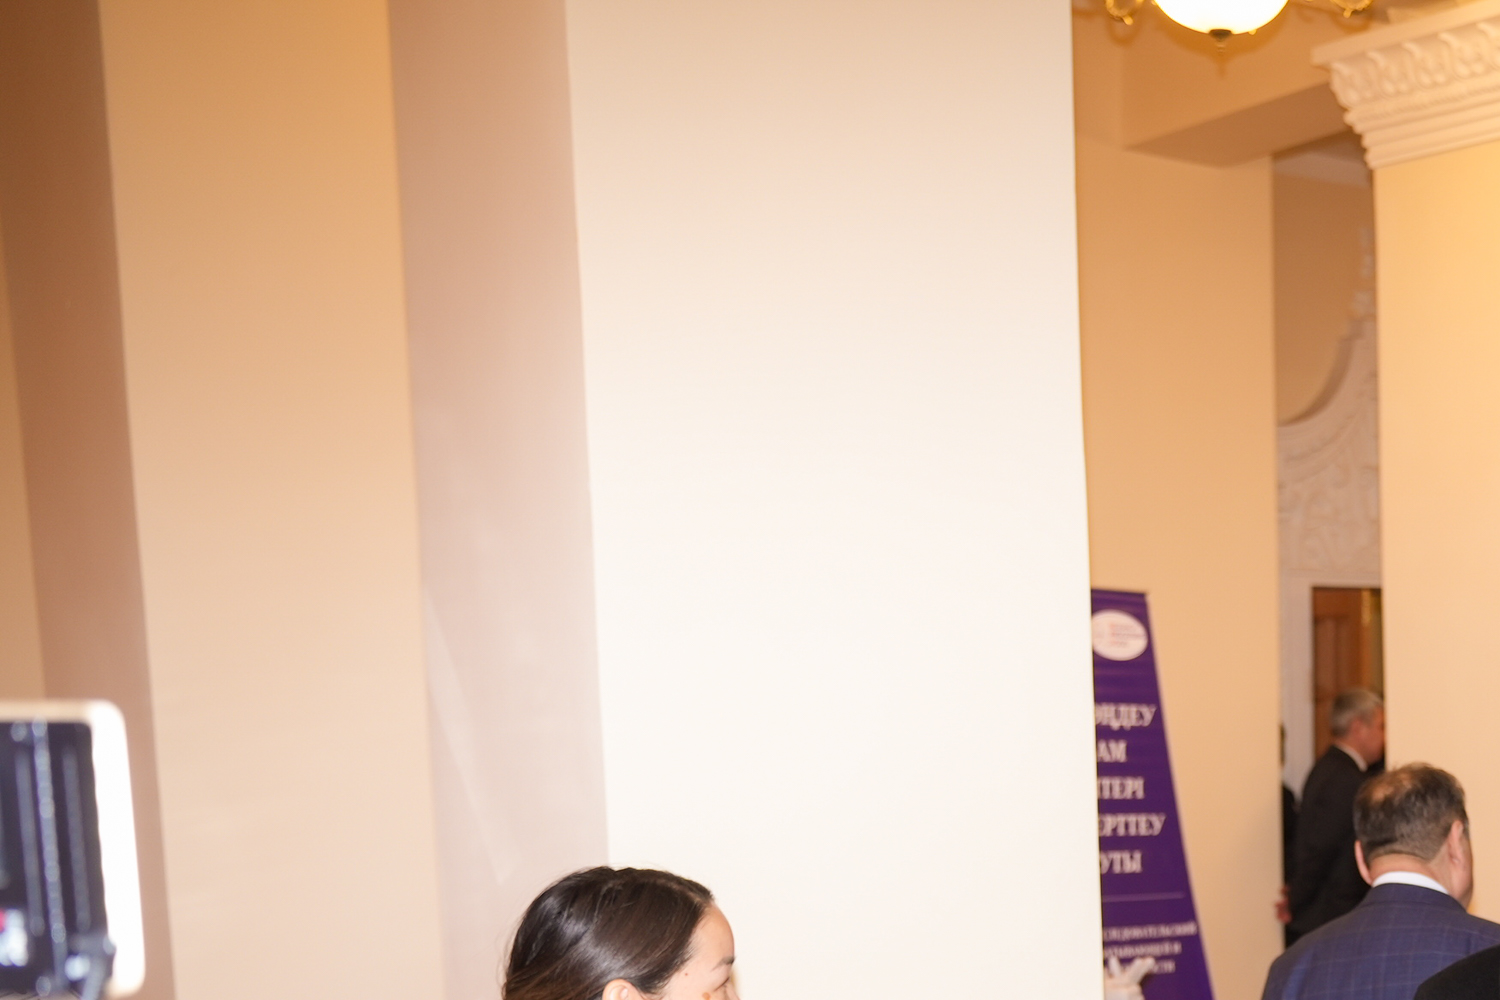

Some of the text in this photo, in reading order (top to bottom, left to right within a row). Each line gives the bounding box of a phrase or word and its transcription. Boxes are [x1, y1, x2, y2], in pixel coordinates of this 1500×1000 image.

[1097, 739, 1128, 762] АМ
[1098, 776, 1145, 799] ТЕРІ
[1100, 850, 1142, 874] УТЫ
